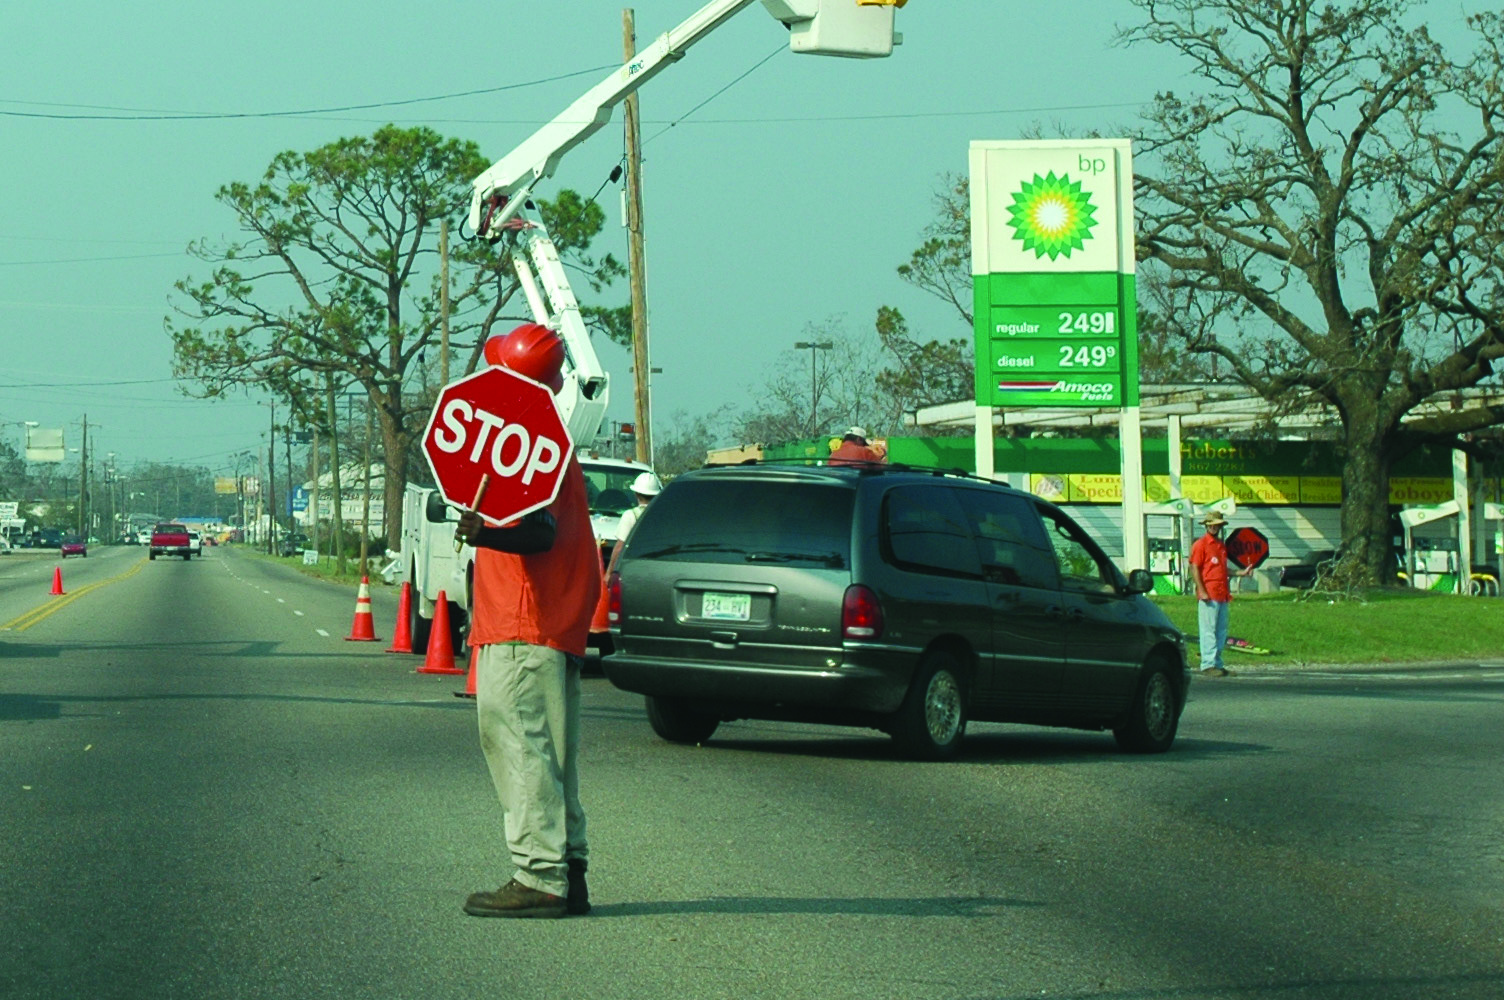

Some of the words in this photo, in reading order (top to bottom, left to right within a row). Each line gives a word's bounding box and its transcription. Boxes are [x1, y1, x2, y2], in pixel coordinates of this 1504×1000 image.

[1078, 153, 1105, 176] bp
[996, 322, 1040, 336] regular
[997, 355, 1034, 367] diesel
[1051, 380, 1114, 393] Amoco
[434, 398, 561, 486] STOP
